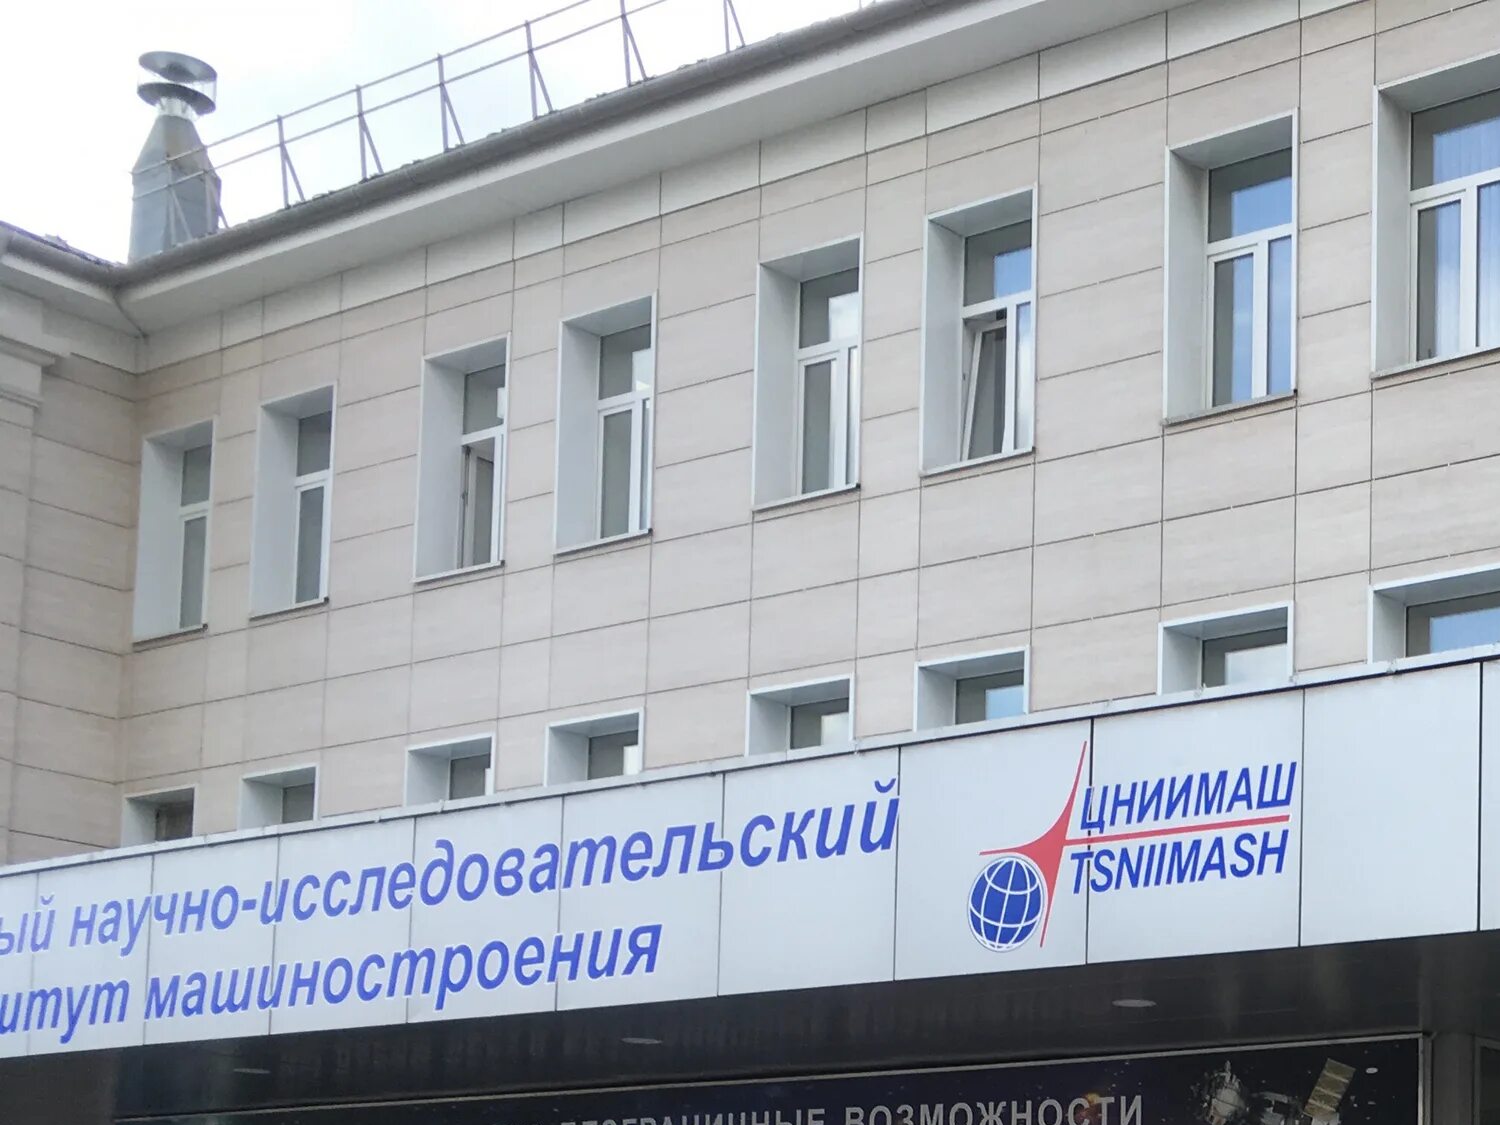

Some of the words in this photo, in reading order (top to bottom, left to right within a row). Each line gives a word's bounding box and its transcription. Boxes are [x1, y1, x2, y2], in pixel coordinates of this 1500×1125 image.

[1079, 761, 1297, 835] ЦНИИМАШ
[69, 778, 900, 957] научно-исследовательский
[1070, 829, 1289, 894] TSNIIMASH
[144, 924, 663, 1019] машиностроения
